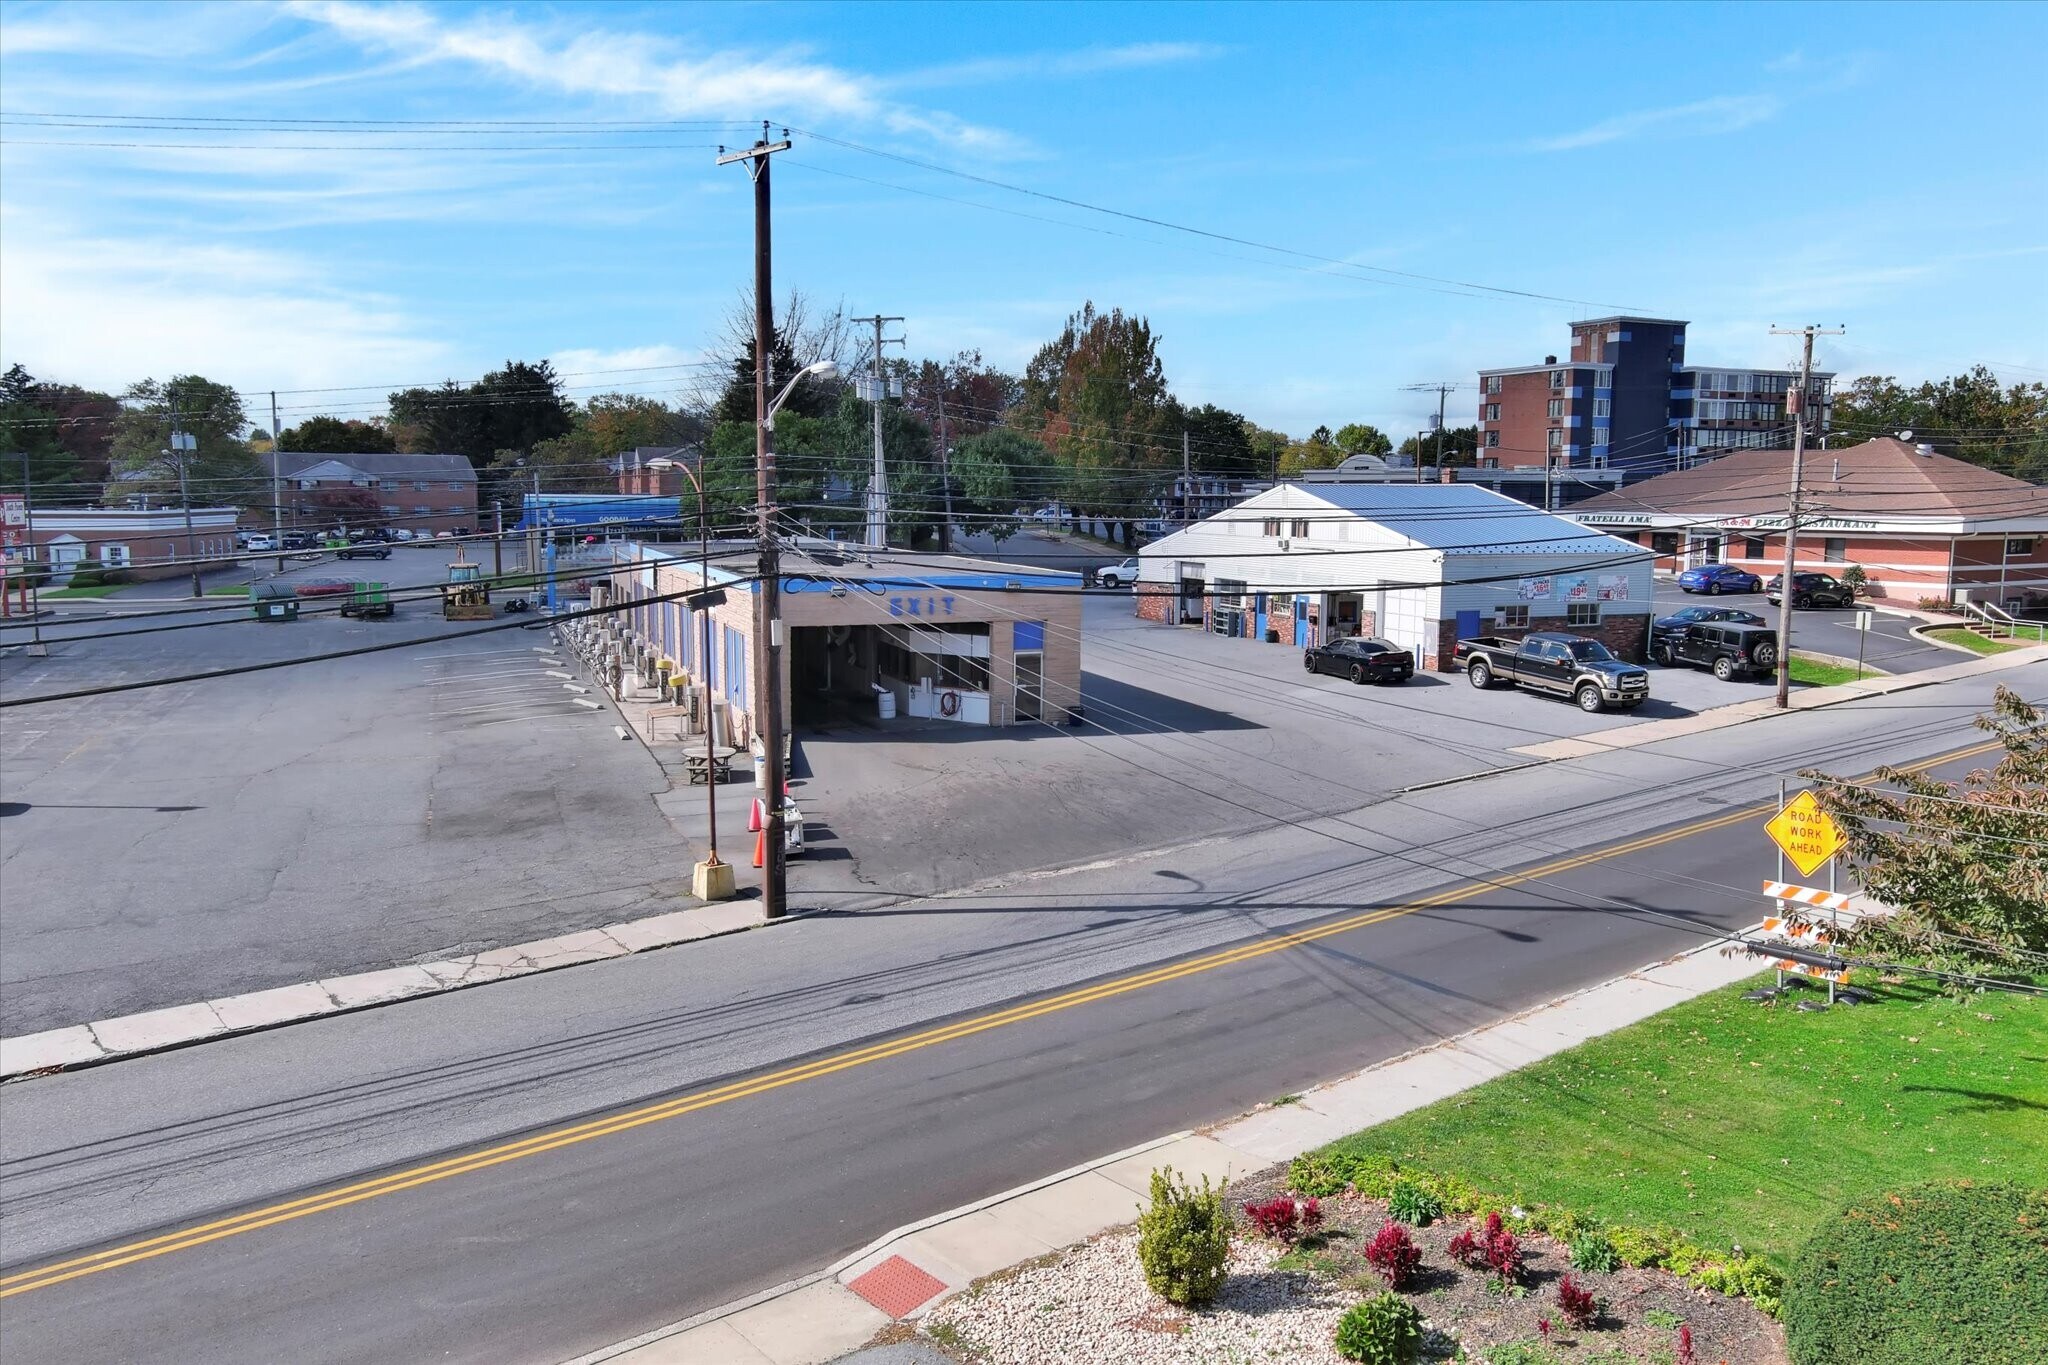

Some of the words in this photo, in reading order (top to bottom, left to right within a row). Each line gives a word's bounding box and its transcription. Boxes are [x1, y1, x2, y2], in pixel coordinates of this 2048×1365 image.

[1577, 515, 1625, 523] FRATELLI
[1720, 518, 1751, 527] A&M
[1755, 519, 1788, 527] PIZZA
[890, 596, 955, 616] EXIT
[1790, 810, 1822, 825] ROAD
[1790, 826, 1822, 840] WORK
[1790, 842, 1823, 856] AHEAD
